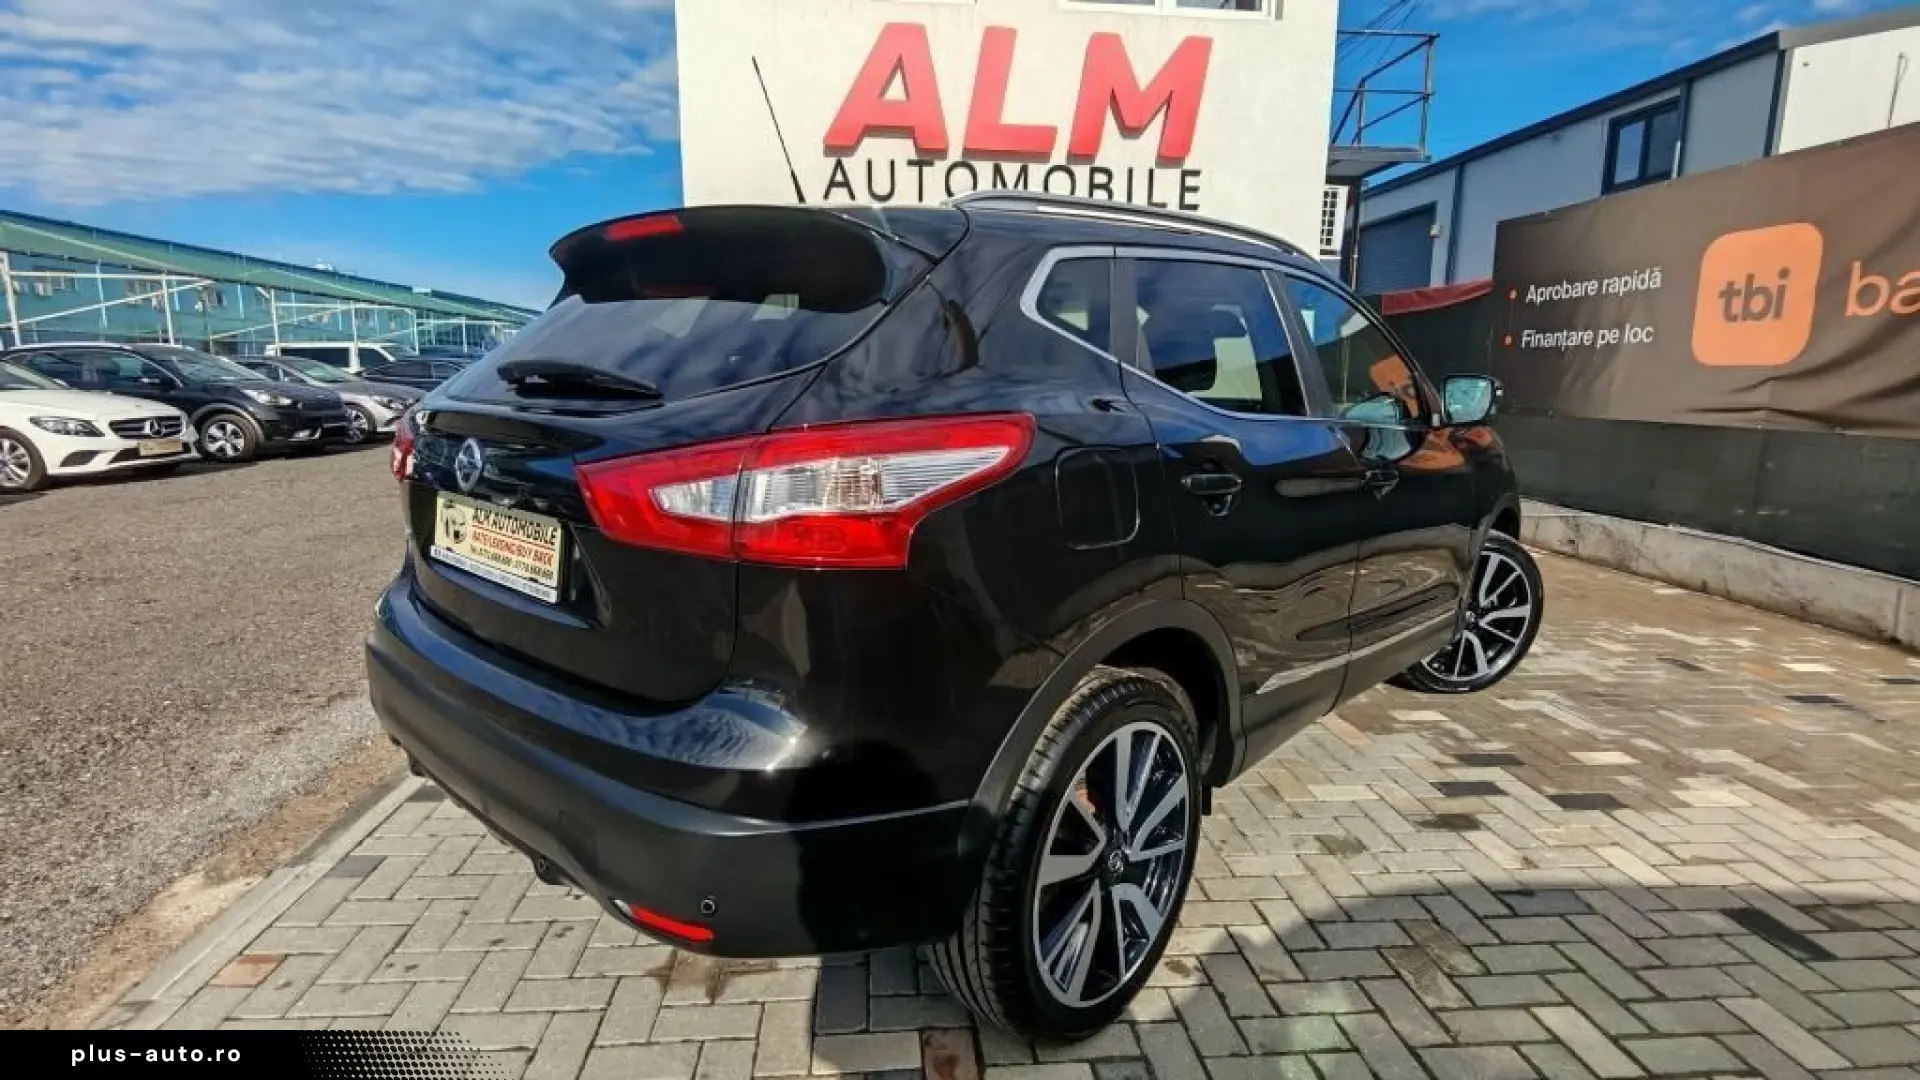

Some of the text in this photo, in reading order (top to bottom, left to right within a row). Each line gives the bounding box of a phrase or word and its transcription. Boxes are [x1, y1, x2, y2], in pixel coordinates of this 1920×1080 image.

[823, 22, 1213, 167] ALM
[823, 158, 1202, 210] AUTOMOBILE
[1525, 266, 1662, 306] Aprobare rapidă
[1718, 267, 1790, 323] tbi
[1521, 322, 1655, 351] Finanțare pe loc
[491, 512, 556, 546] AUTOMOBILE
